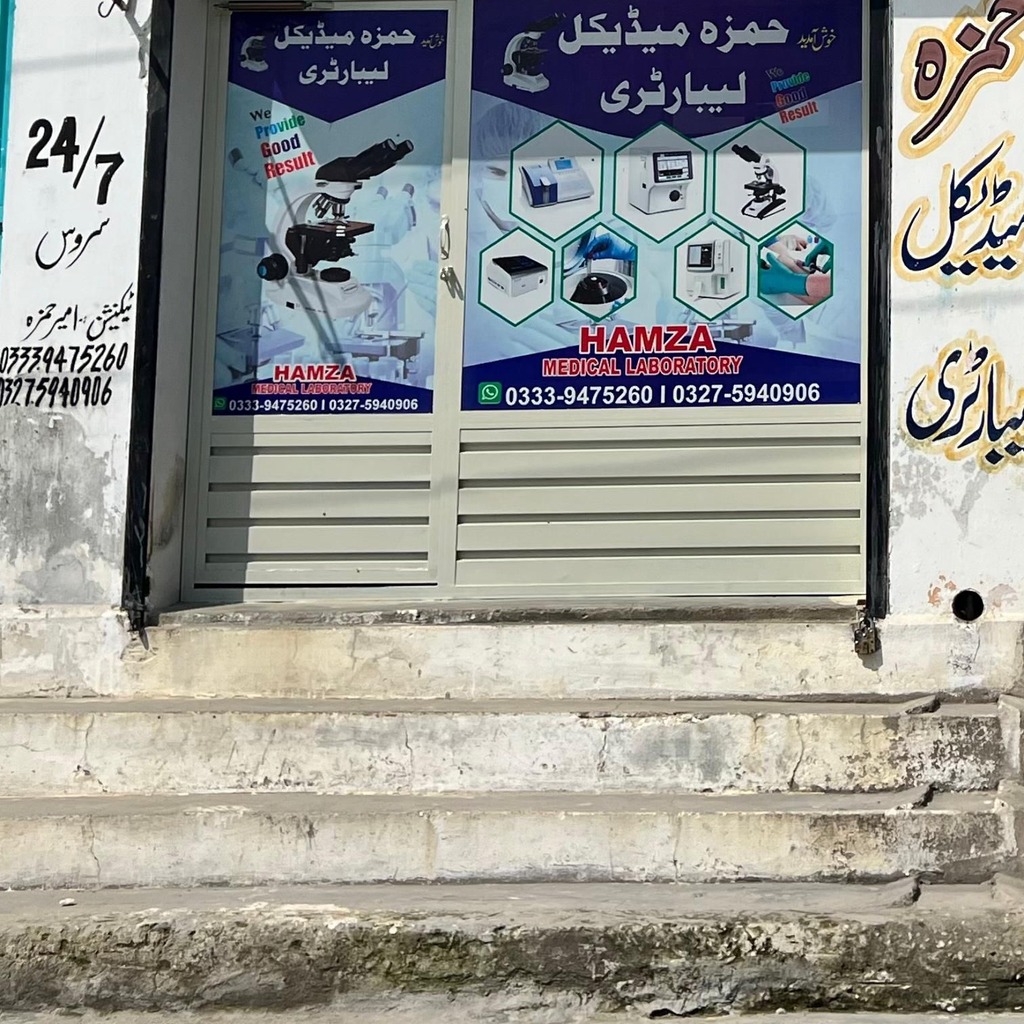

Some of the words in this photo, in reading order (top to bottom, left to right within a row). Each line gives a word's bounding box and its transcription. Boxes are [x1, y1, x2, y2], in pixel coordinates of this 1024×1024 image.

[273, 20, 356, 50] میڈیکل
[360, 26, 416, 50] حمزہ
[557, 4, 691, 55] میڈیکل
[700, 13, 790, 54] حمزہ
[298, 57, 389, 86] لیبارٹری
[770, 72, 811, 93] Provide
[599, 66, 747, 116] لیبارٹری
[249, 108, 272, 122] We
[779, 101, 819, 125] Result
[255, 115, 306, 140] Provide
[260, 133, 301, 158] Good
[25, 115, 125, 206] 24/7
[264, 150, 316, 179] Result
[35, 217, 110, 270] سروس
[20, 302, 57, 342] حمزہ
[38, 303, 78, 341] امیر
[579, 324, 716, 354] HAMZA
[273, 364, 357, 382] HAMZA
[542, 358, 621, 377] MEDICAL
[625, 355, 744, 375] LABORATORY
[251, 382, 299, 395] MEDICAL
[301, 382, 372, 395] LABORATORY
[505, 385, 653, 406] 0333-9475260
[672, 382, 820, 404] 0327-5940906
[228, 399, 318, 412] 0333-9475260
[328, 398, 419, 412] 0327-5940906
